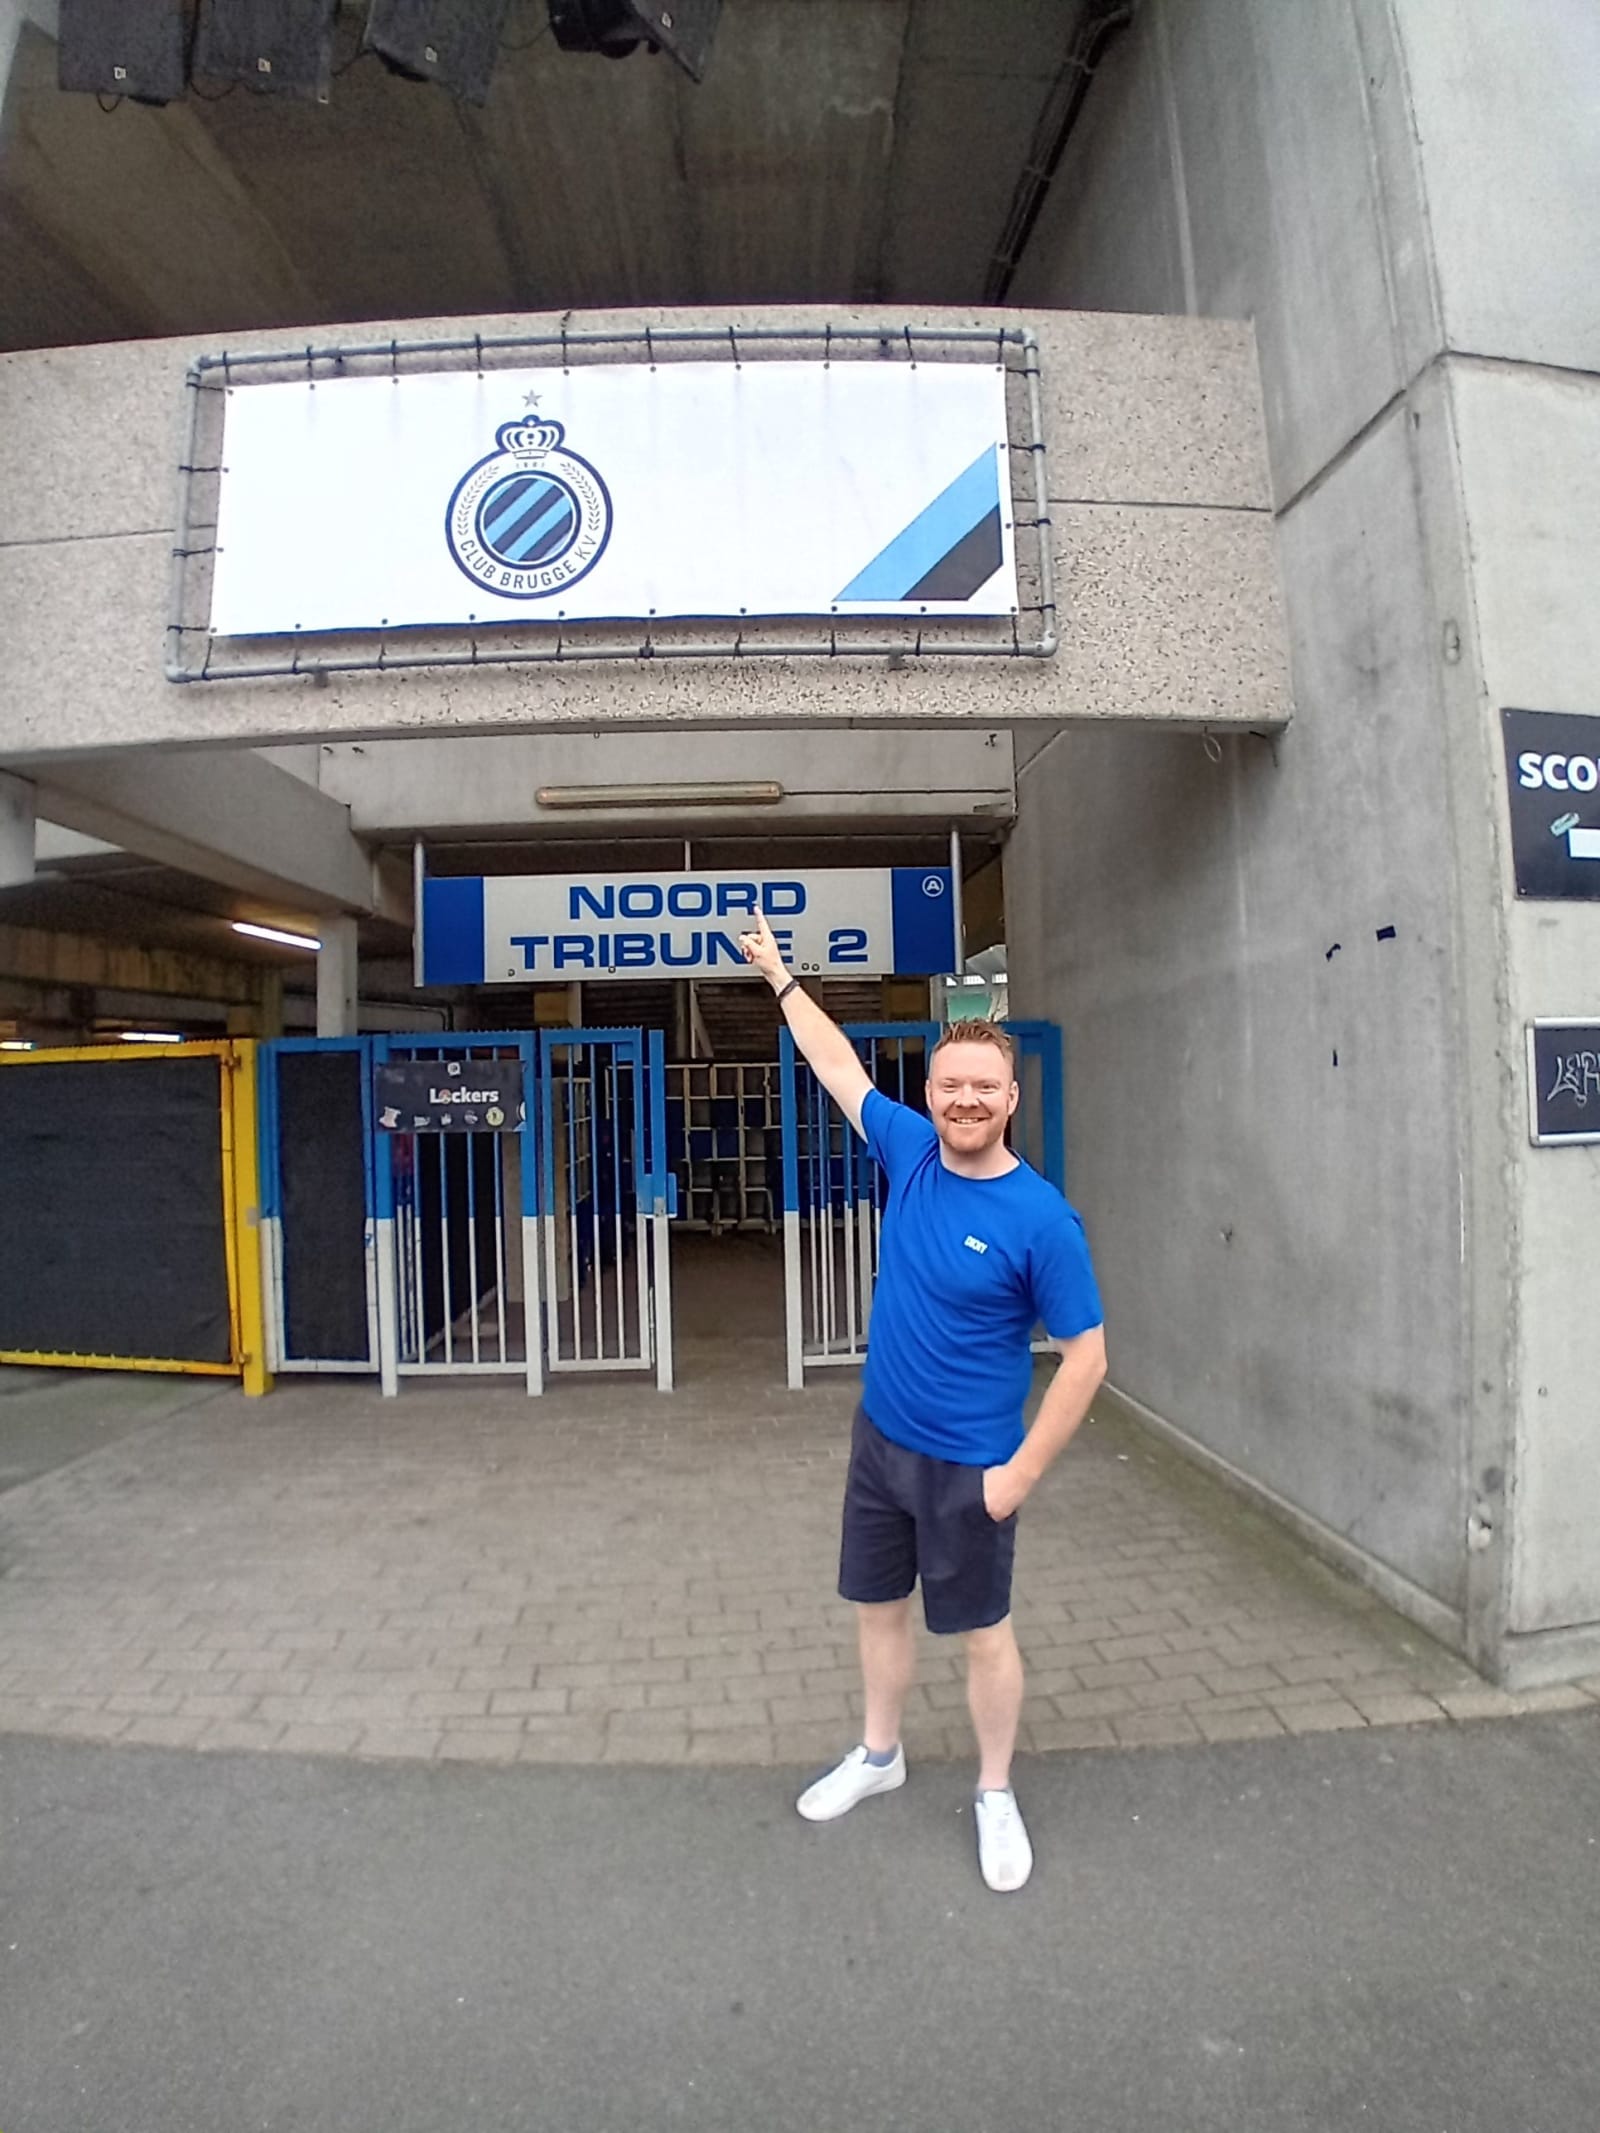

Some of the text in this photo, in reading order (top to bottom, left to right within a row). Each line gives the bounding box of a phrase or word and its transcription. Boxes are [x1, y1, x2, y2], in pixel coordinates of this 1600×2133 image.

[460, 534, 597, 589] CLUB BRUGGE KV
[1518, 751, 1600, 792] SCO
[569, 881, 806, 920] NOORD
[828, 928, 868, 962] 2
[429, 1086, 499, 1105] Lockers
